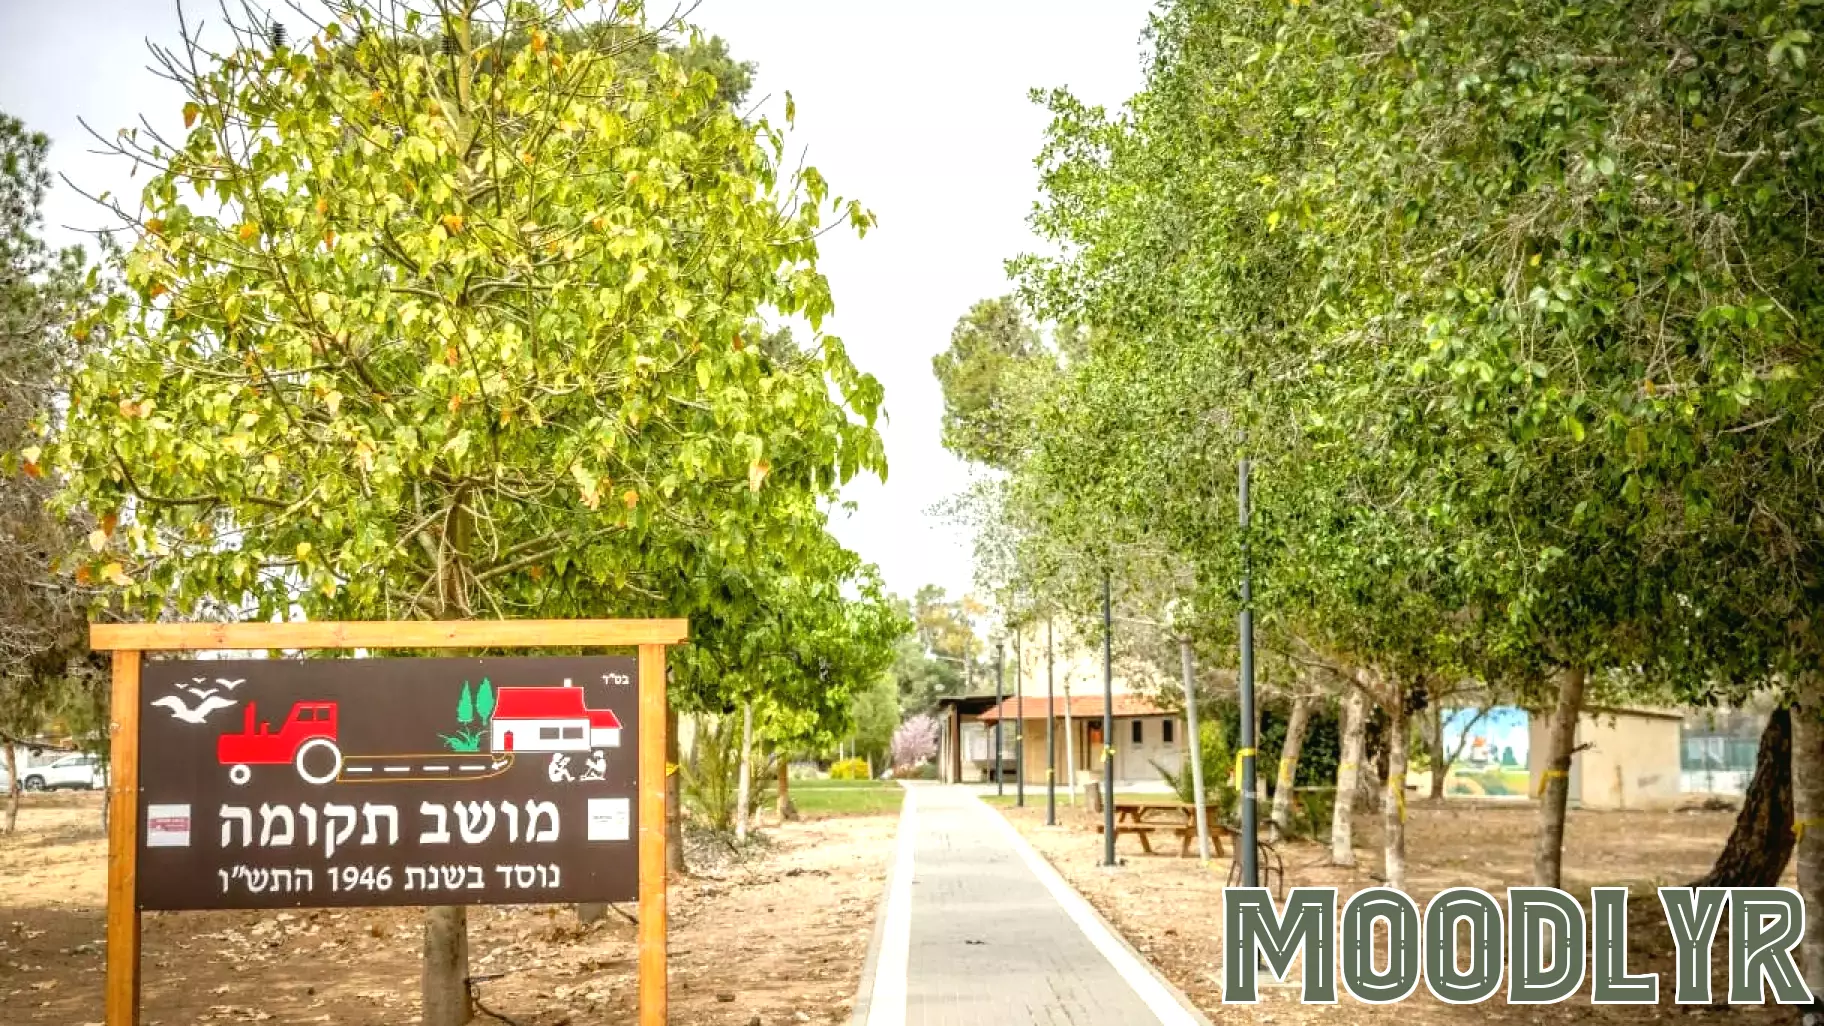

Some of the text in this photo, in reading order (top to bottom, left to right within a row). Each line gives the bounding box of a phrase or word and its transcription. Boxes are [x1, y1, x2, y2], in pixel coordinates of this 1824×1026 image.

[219, 798, 561, 858] מושב תקומה
[327, 866, 393, 892] 1946
[404, 865, 485, 890] בשנת
[496, 863, 561, 889] נוסד
